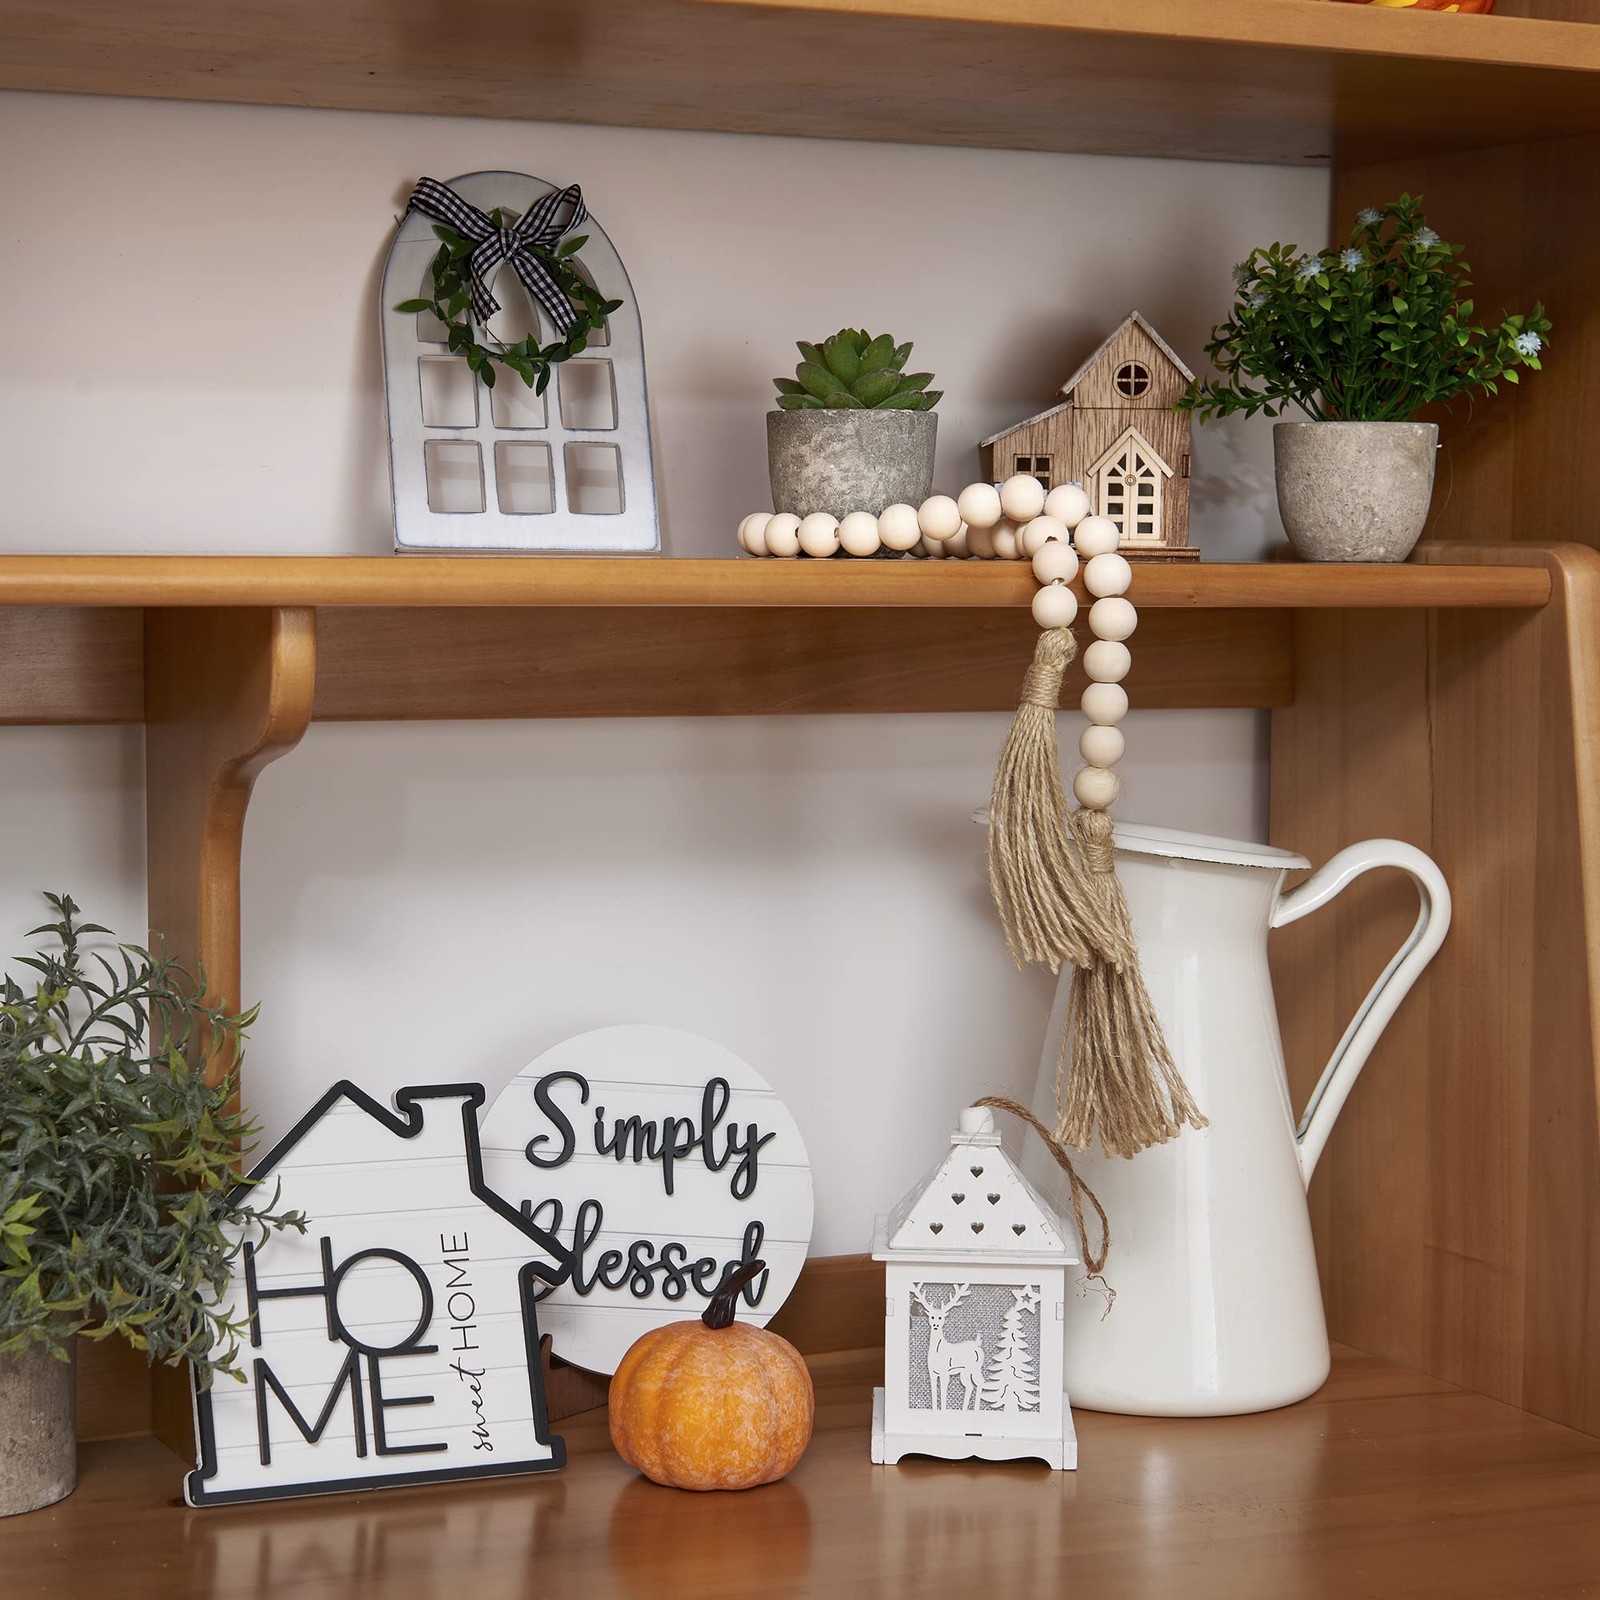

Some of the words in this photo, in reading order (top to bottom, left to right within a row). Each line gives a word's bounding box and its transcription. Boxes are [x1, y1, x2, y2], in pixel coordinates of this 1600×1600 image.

[525, 1070, 776, 1200] Simply
[440, 1231, 480, 1351] HOME
[449, 1356, 494, 1452] sweet
